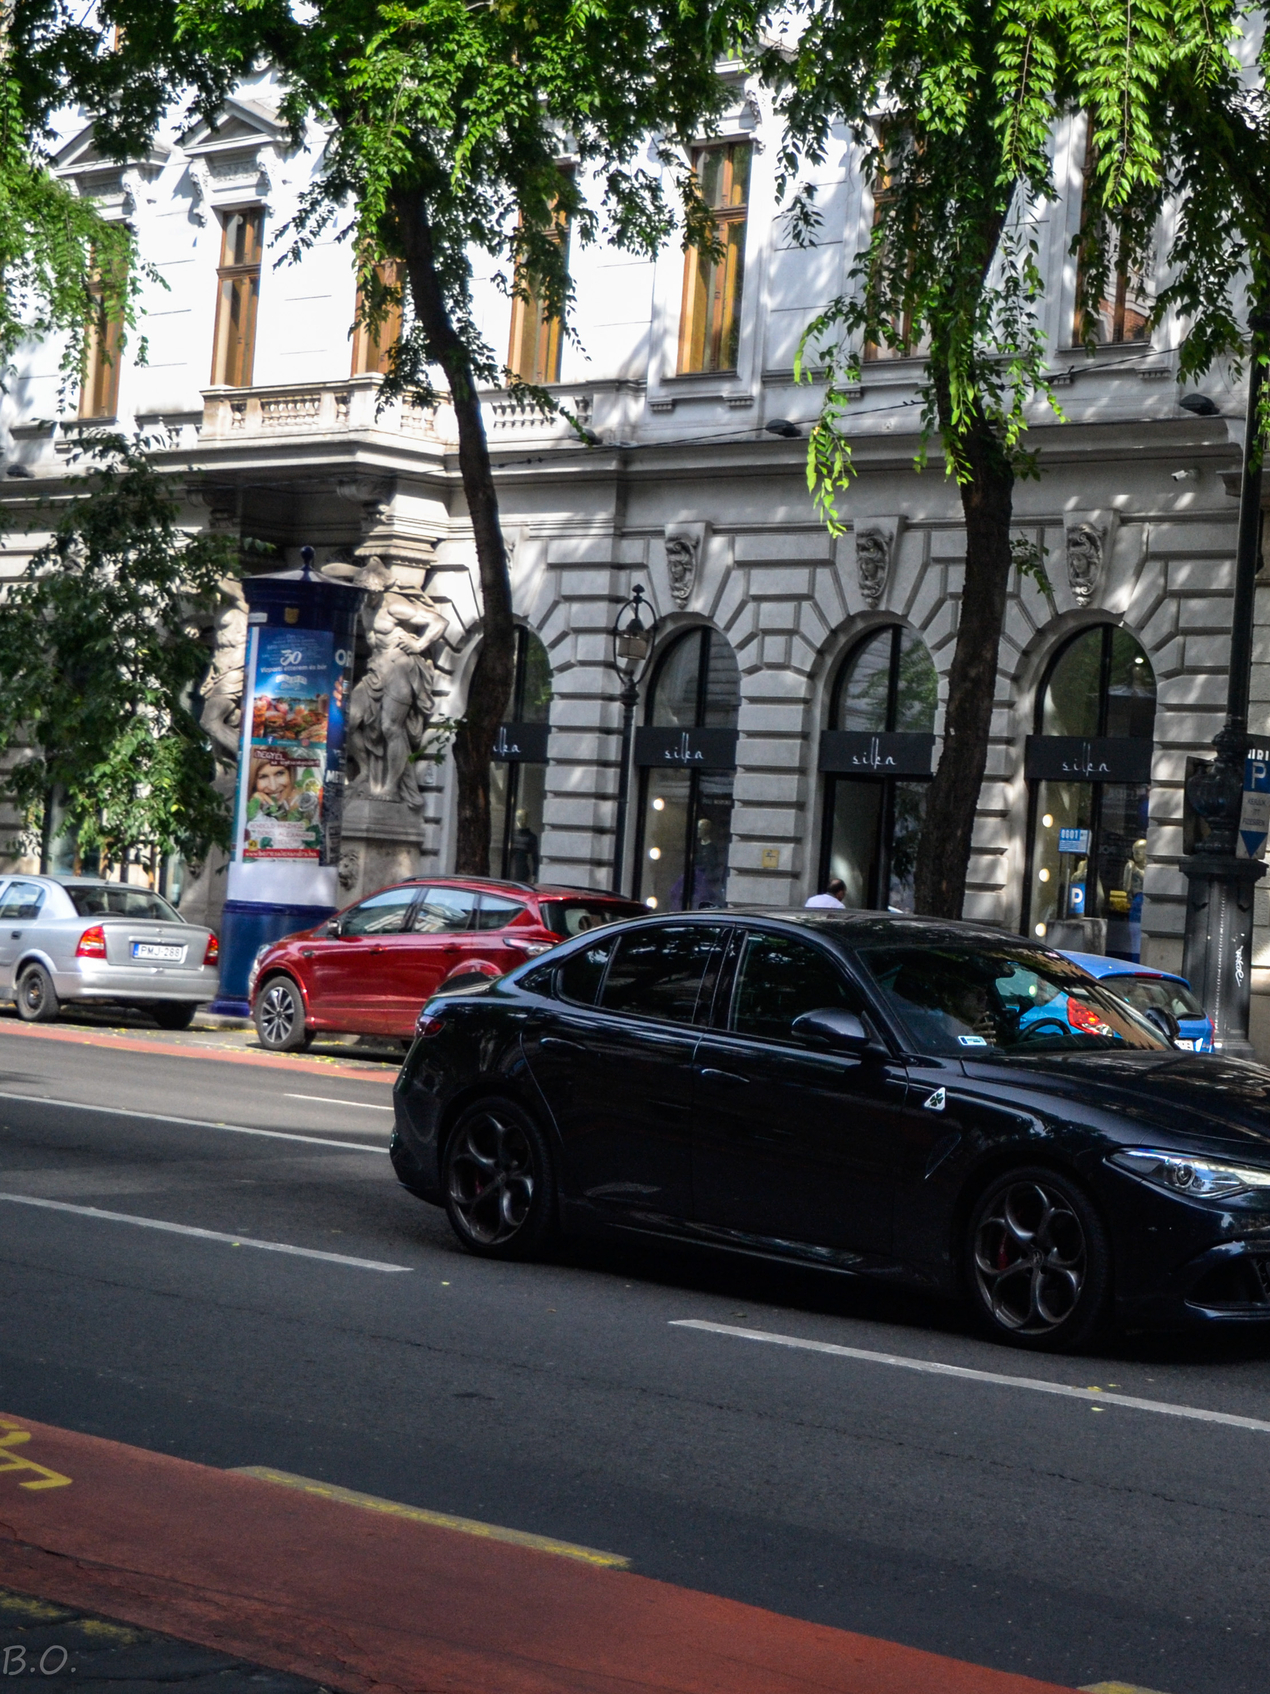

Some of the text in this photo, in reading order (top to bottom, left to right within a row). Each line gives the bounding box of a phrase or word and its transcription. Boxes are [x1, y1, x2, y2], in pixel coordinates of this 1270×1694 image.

[280, 649, 302, 665] 30
[852, 737, 897, 769] silka
[1062, 742, 1111, 776] silka
[1251, 762, 1266, 788] P
[1071, 887, 1083, 908] P
[141, 945, 180, 957] PMJ-288
